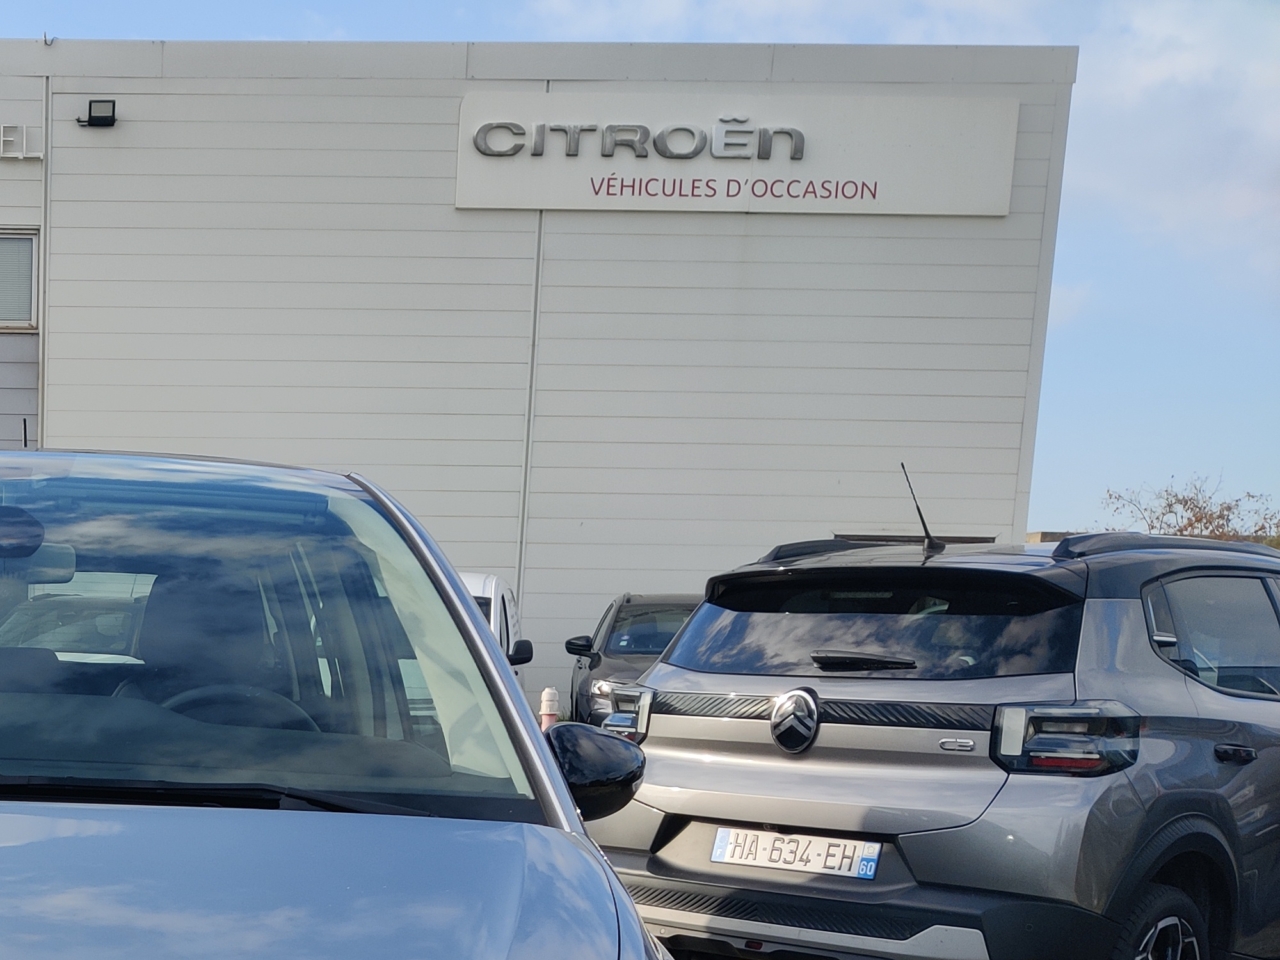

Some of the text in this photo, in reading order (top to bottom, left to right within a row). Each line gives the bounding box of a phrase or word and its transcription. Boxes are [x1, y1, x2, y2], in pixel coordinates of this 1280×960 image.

[590, 173, 879, 201] VÉHICULES D'OCCASION
[938, 738, 975, 751] C3
[729, 832, 858, 872] HA-634-EH
[859, 861, 875, 876] 60
